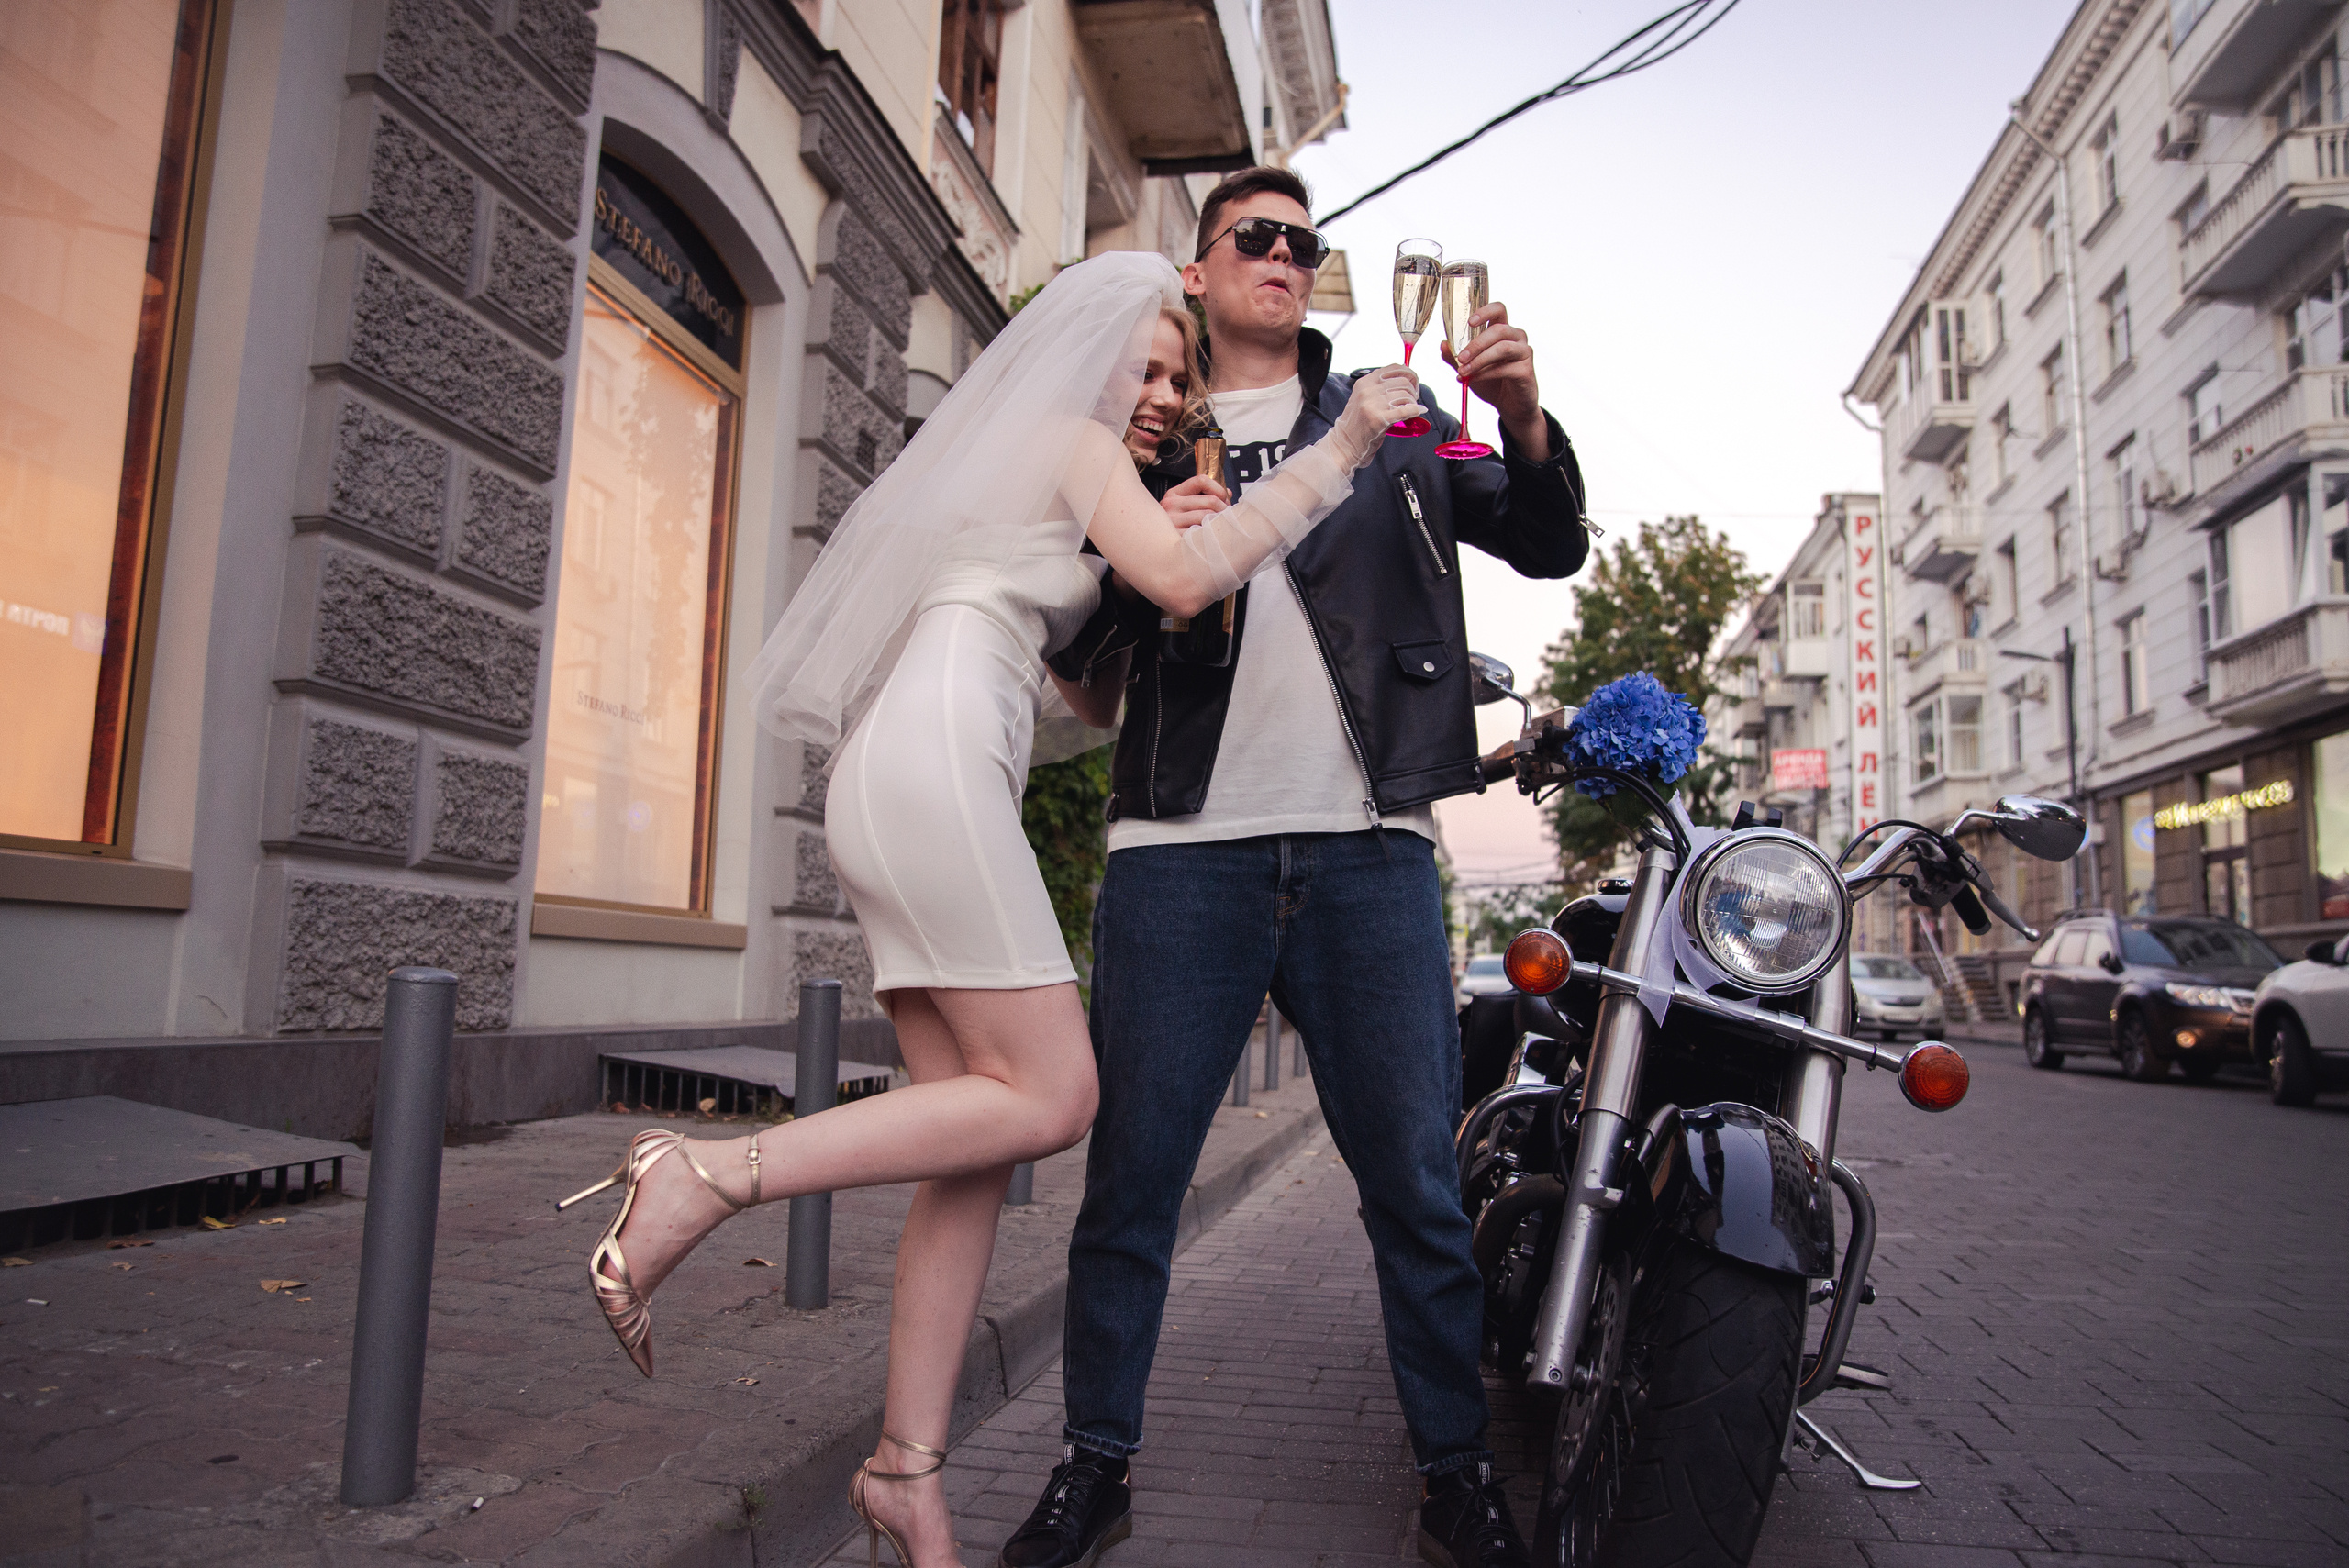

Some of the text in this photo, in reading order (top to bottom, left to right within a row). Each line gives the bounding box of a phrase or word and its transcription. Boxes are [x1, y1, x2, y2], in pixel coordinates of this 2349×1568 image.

[595, 187, 734, 337] STEFANO RICCI
[1855, 516, 1877, 728] РУССКИЙ
[577, 691, 619, 717] STEFANO
